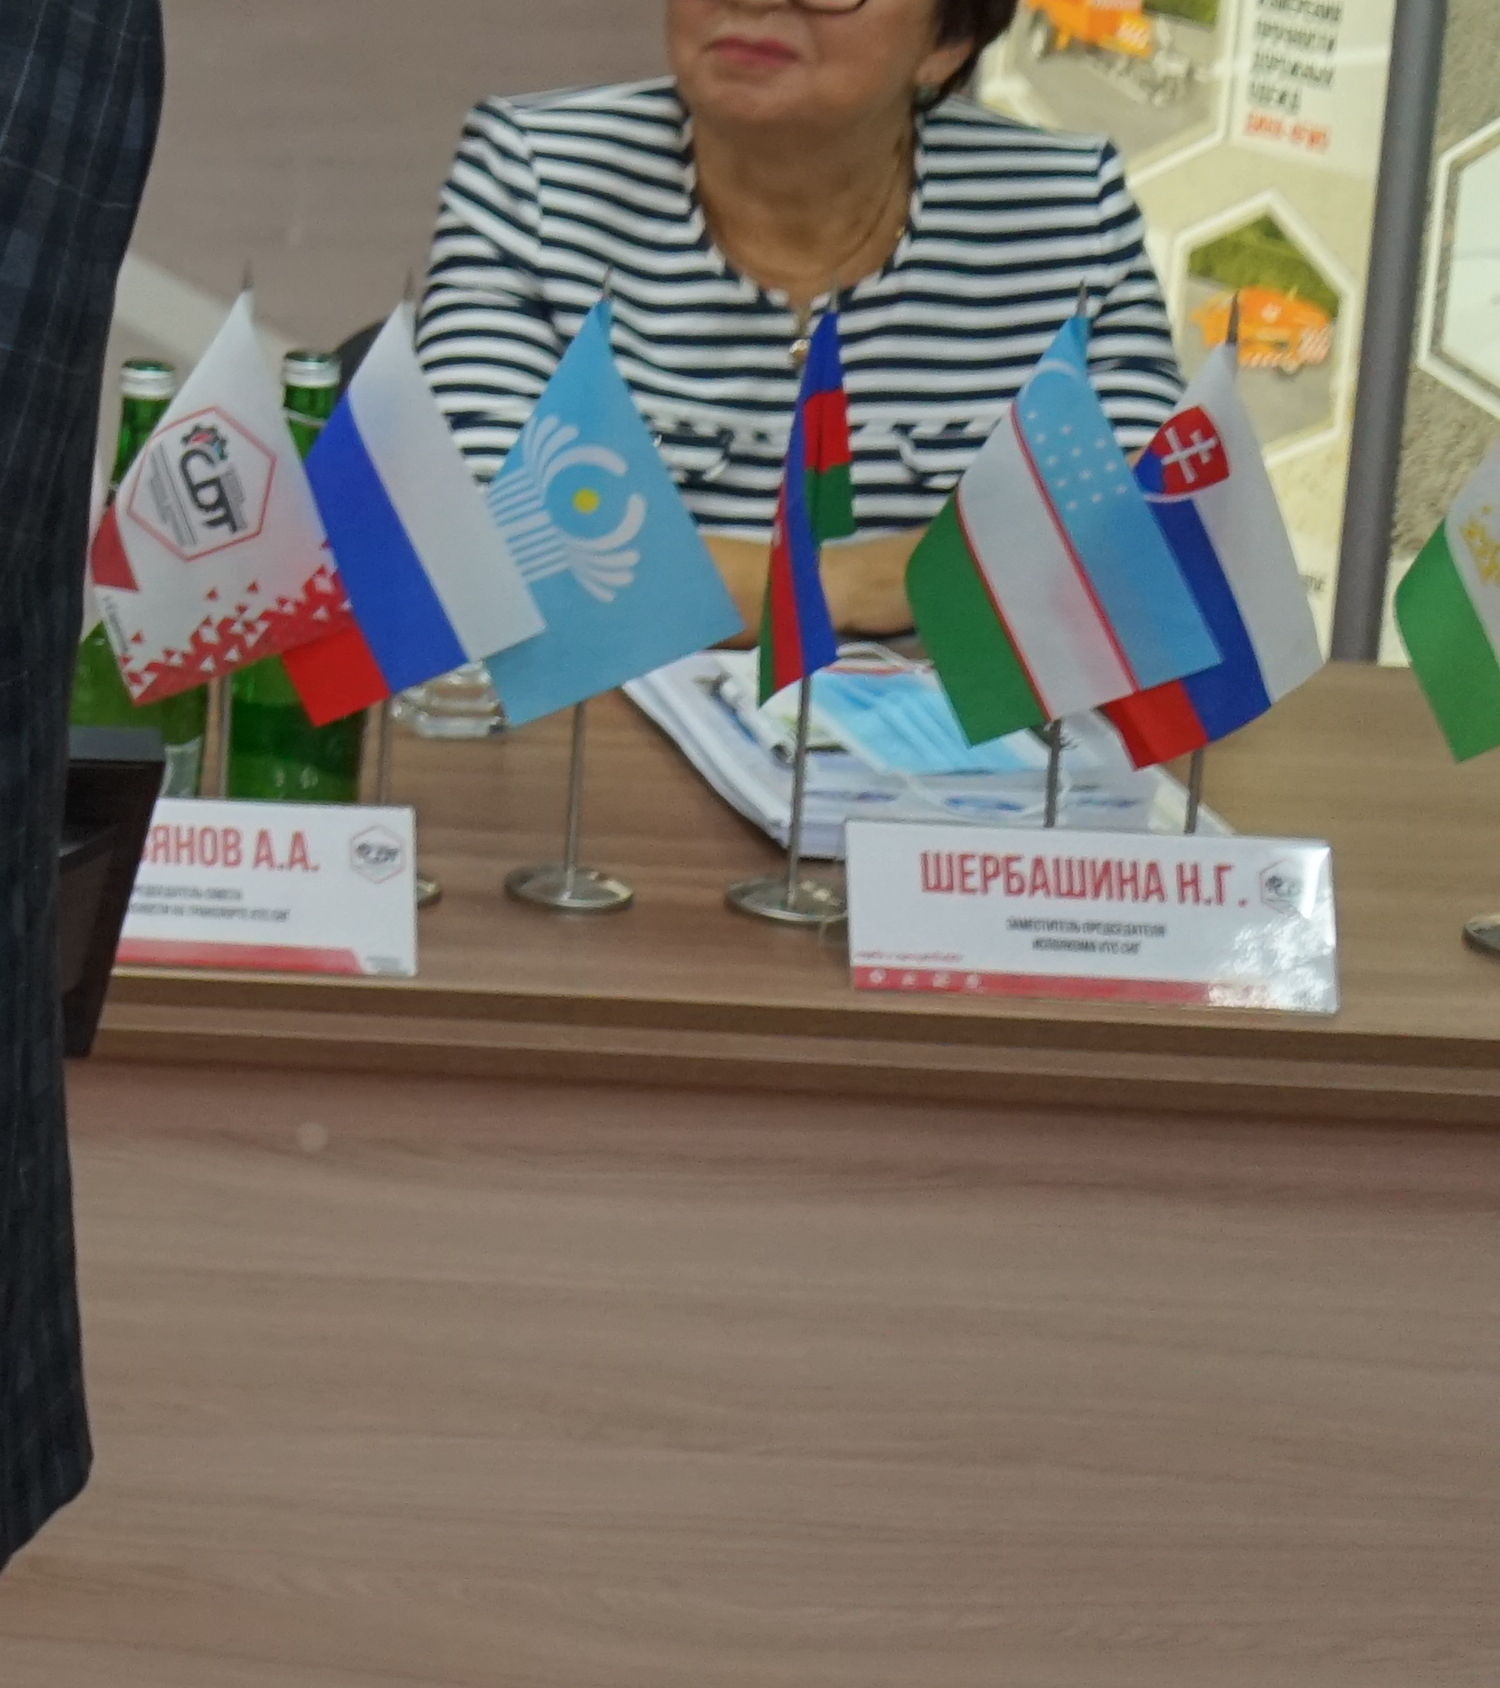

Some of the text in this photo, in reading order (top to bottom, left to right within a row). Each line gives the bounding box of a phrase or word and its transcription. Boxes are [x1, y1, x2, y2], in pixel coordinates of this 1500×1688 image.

[141, 824, 321, 872] ЯНОВ А.А.
[920, 850, 1167, 903] ШЕРБАШИНА
[1176, 861, 1248, 908] Н.Г.
